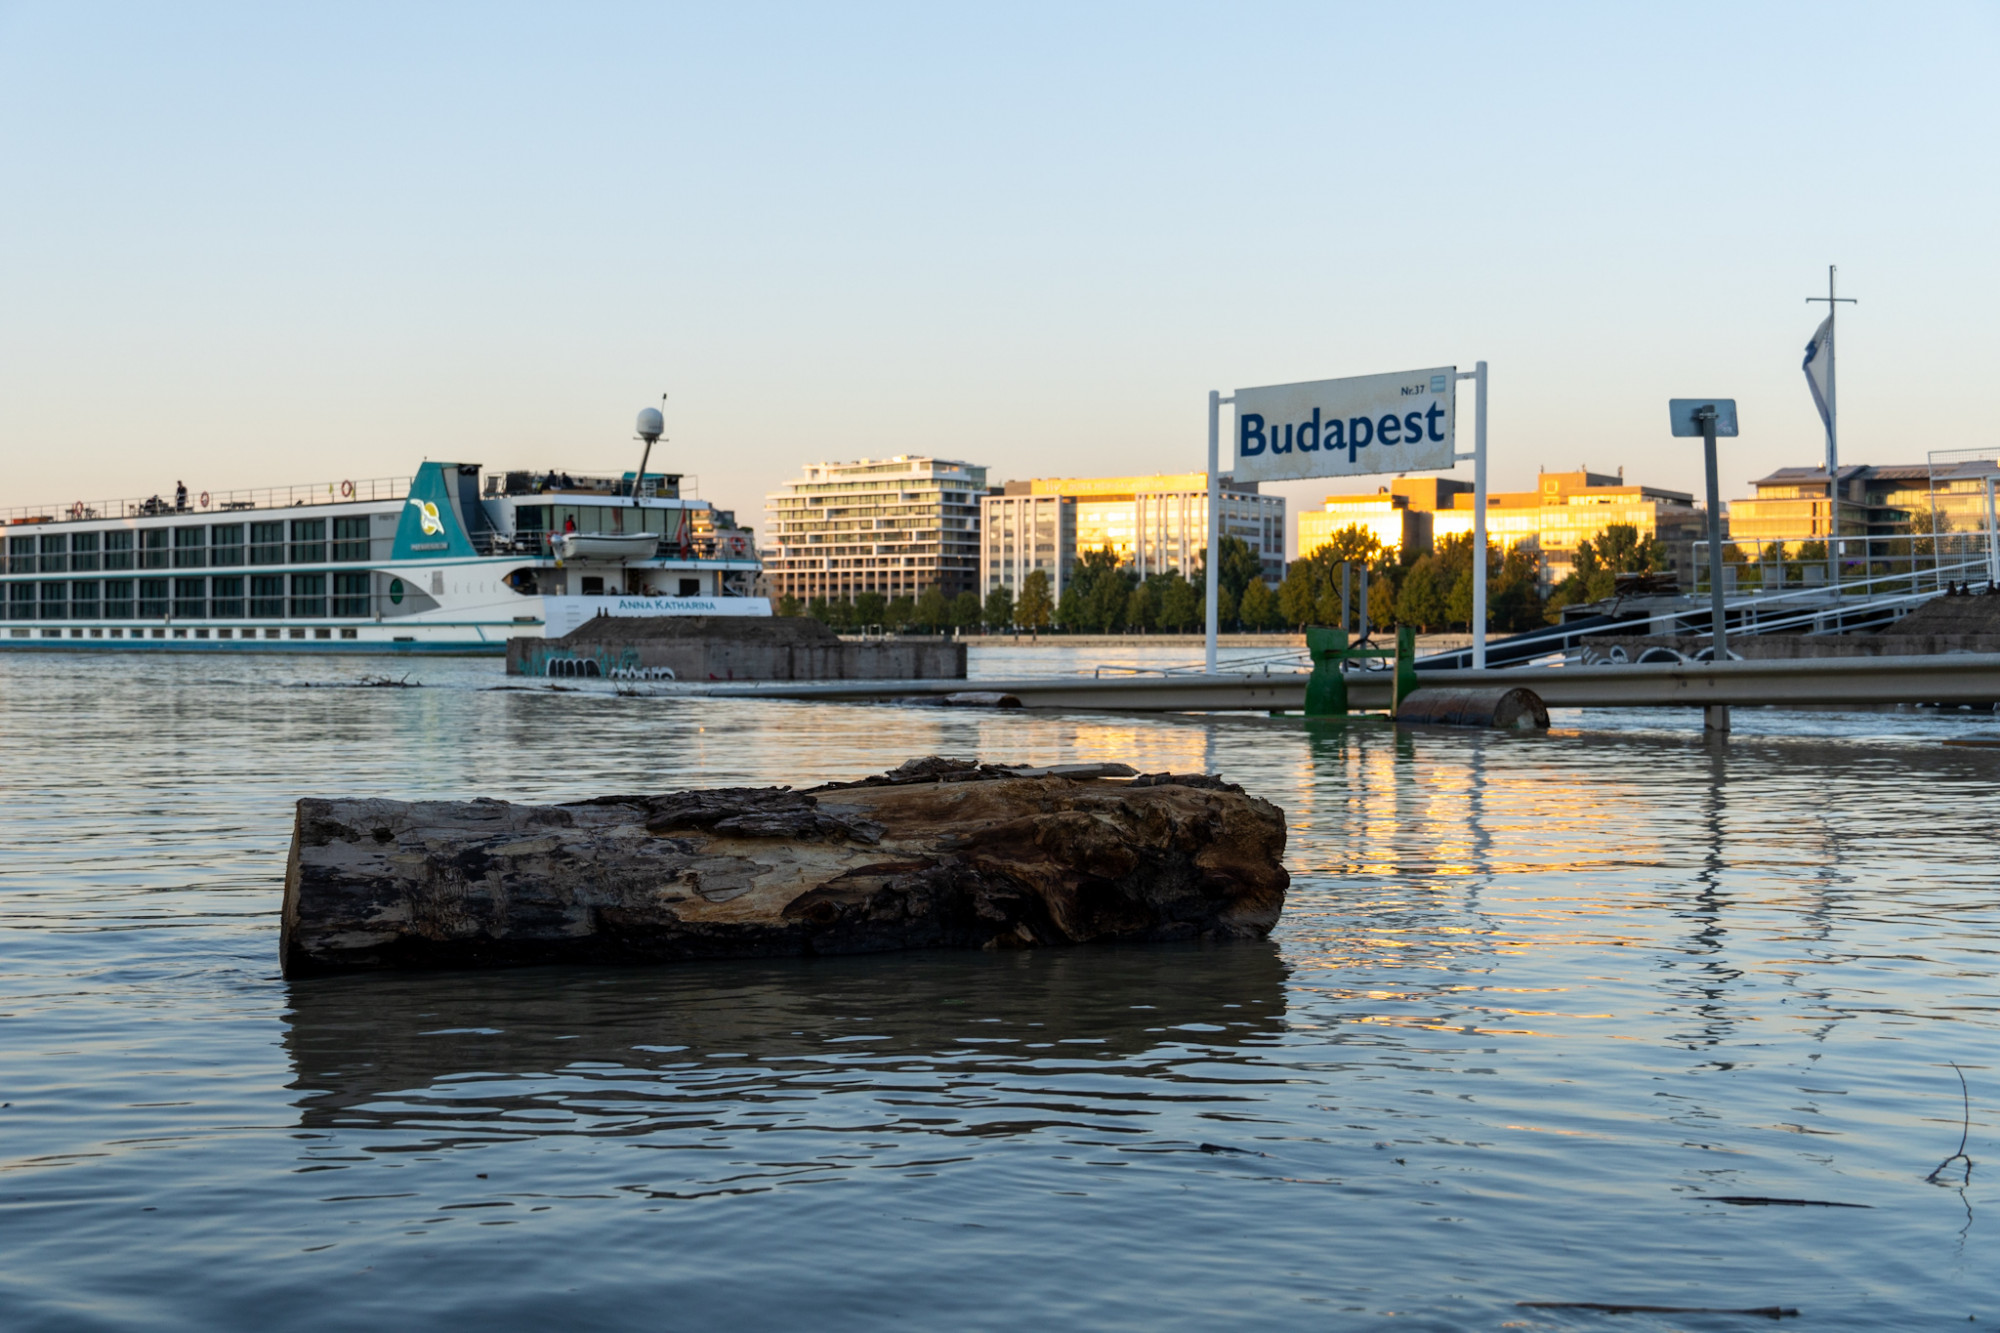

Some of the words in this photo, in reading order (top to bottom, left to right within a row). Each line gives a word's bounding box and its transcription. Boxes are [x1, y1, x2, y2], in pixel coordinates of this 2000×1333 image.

[1401, 384, 1425, 396] Nr.37
[1240, 401, 1445, 463] Budapest
[655, 599, 716, 610] KATHARINA
